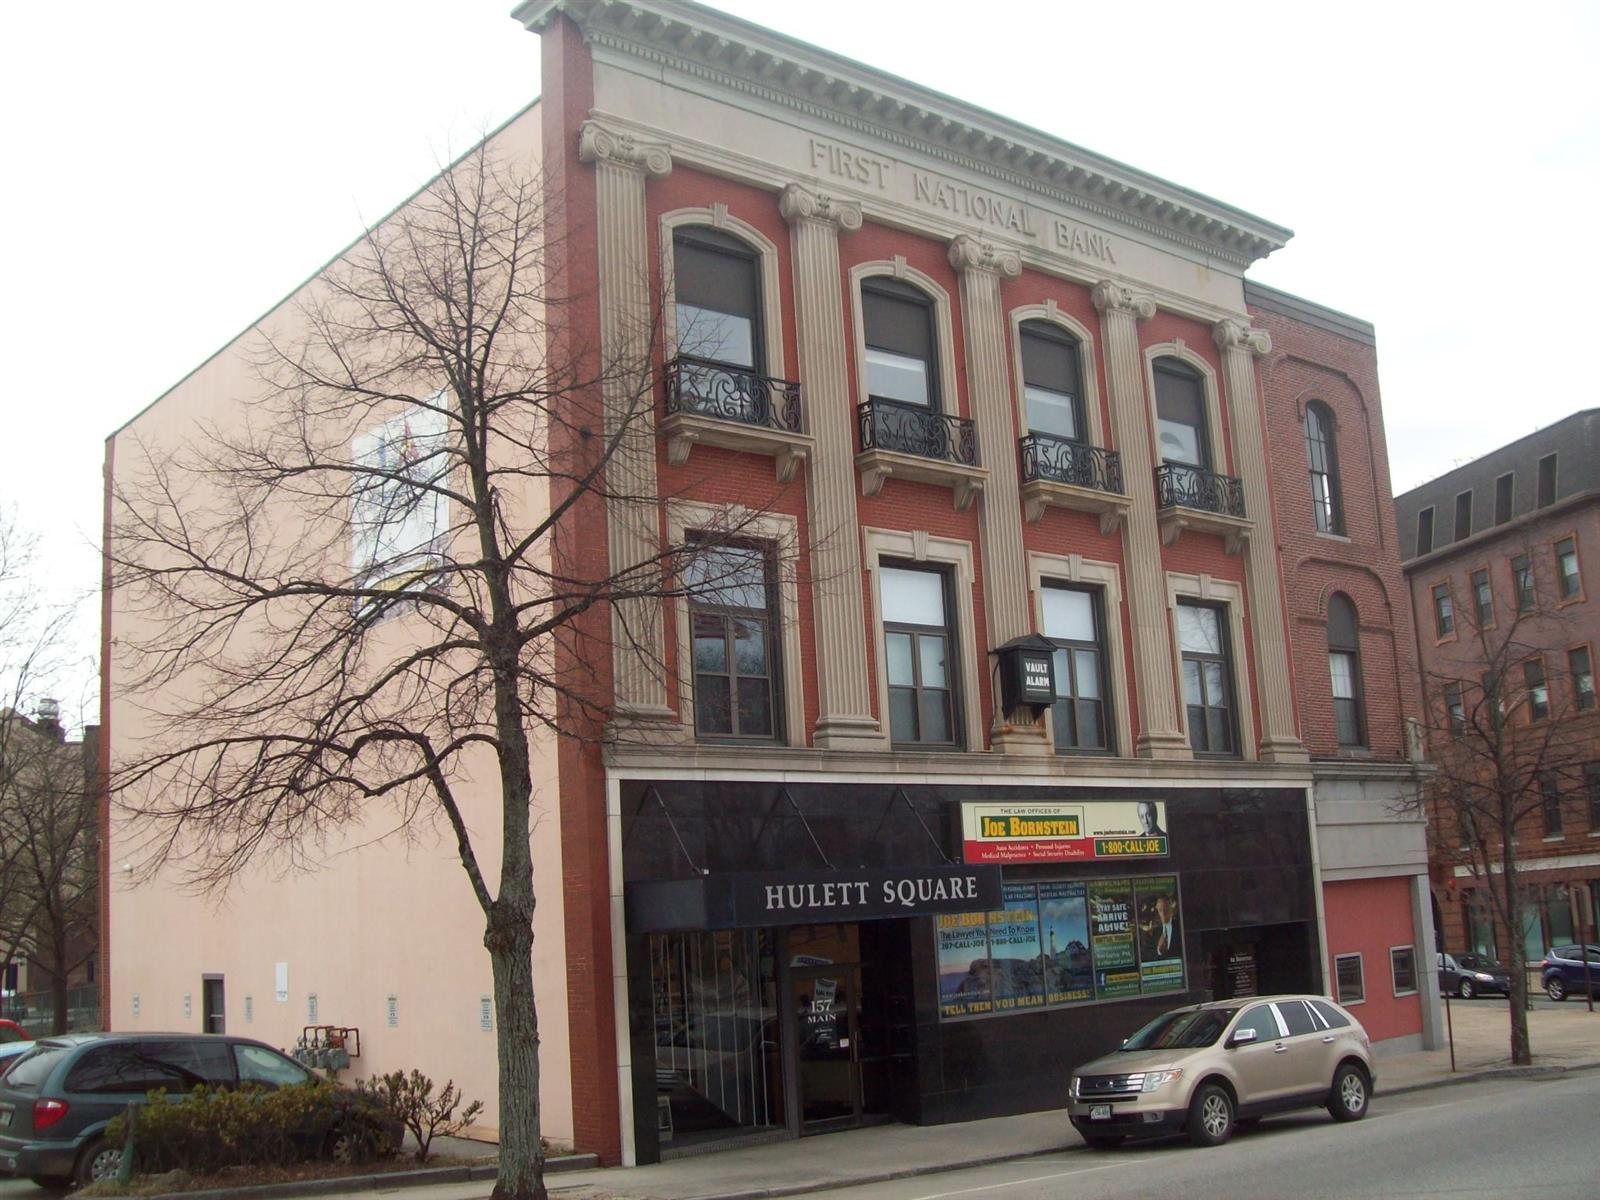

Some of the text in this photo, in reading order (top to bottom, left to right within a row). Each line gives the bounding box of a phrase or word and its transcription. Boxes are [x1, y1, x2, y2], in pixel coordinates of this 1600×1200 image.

[810, 139, 1117, 264] FIRST NATIONAL BANK
[1025, 662, 1048, 674] VAULT
[1026, 676, 1050, 687] ALARM
[765, 876, 978, 910] HULETT SQUARE
[1097, 912, 1128, 922] ARRIVE
[810, 999, 832, 1013] 157
[944, 1004, 966, 1016] TELL
[995, 998, 1015, 1009] YOU
[808, 1014, 837, 1024] MAIN
